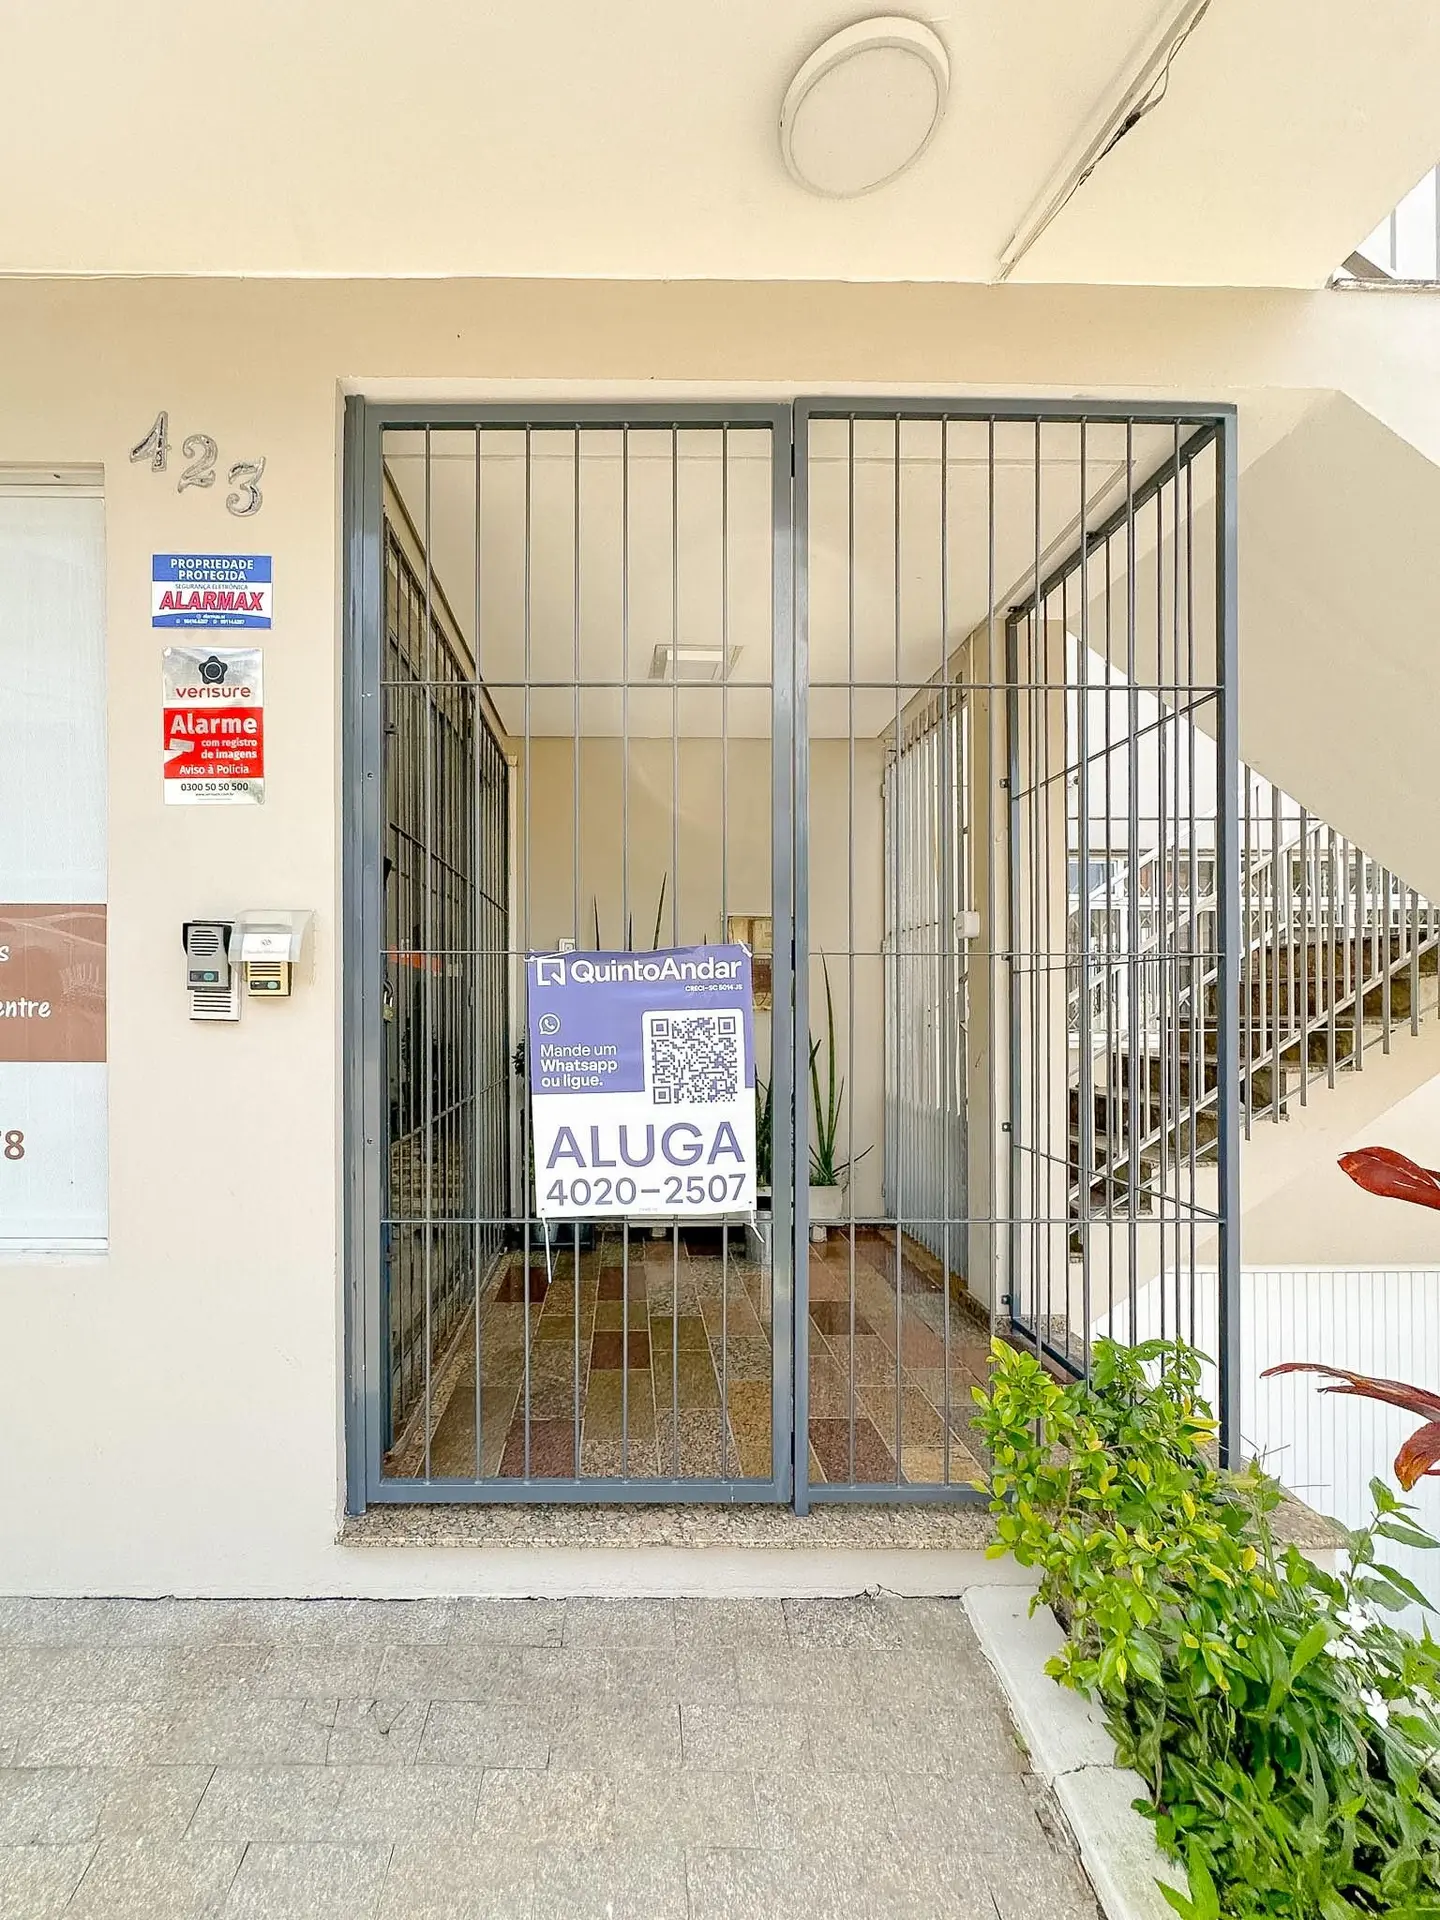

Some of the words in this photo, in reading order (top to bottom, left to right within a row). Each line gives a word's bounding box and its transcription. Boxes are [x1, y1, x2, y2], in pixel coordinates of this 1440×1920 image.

[130, 410, 266, 518] 423
[170, 559, 254, 570] PROPRIEDADE
[178, 570, 247, 581] PROTEGIDA
[159, 590, 264, 611] ALARMAX
[175, 686, 251, 698] verisure
[170, 712, 258, 735] Alarme
[221, 738, 258, 749] registro
[201, 749, 214, 759] de
[215, 749, 258, 760] imagens
[179, 765, 205, 775] Aviso
[207, 764, 214, 775] à
[217, 763, 250, 775] Polícia
[180, 783, 204, 792] 0300
[205, 783, 217, 792] 50
[218, 783, 230, 792] 50
[231, 782, 249, 792] 500
[570, 956, 743, 984] QuintoAndar
[540, 1043, 591, 1058] Mande
[593, 1044, 617, 1056] um
[541, 1058, 618, 1075] Whatsapp
[541, 1076, 561, 1087] ou
[562, 1072, 604, 1090] ligue.
[0, 1130, 25, 1160] 8
[546, 1121, 746, 1169] ALUGA
[546, 1173, 746, 1207] 4020-2507
